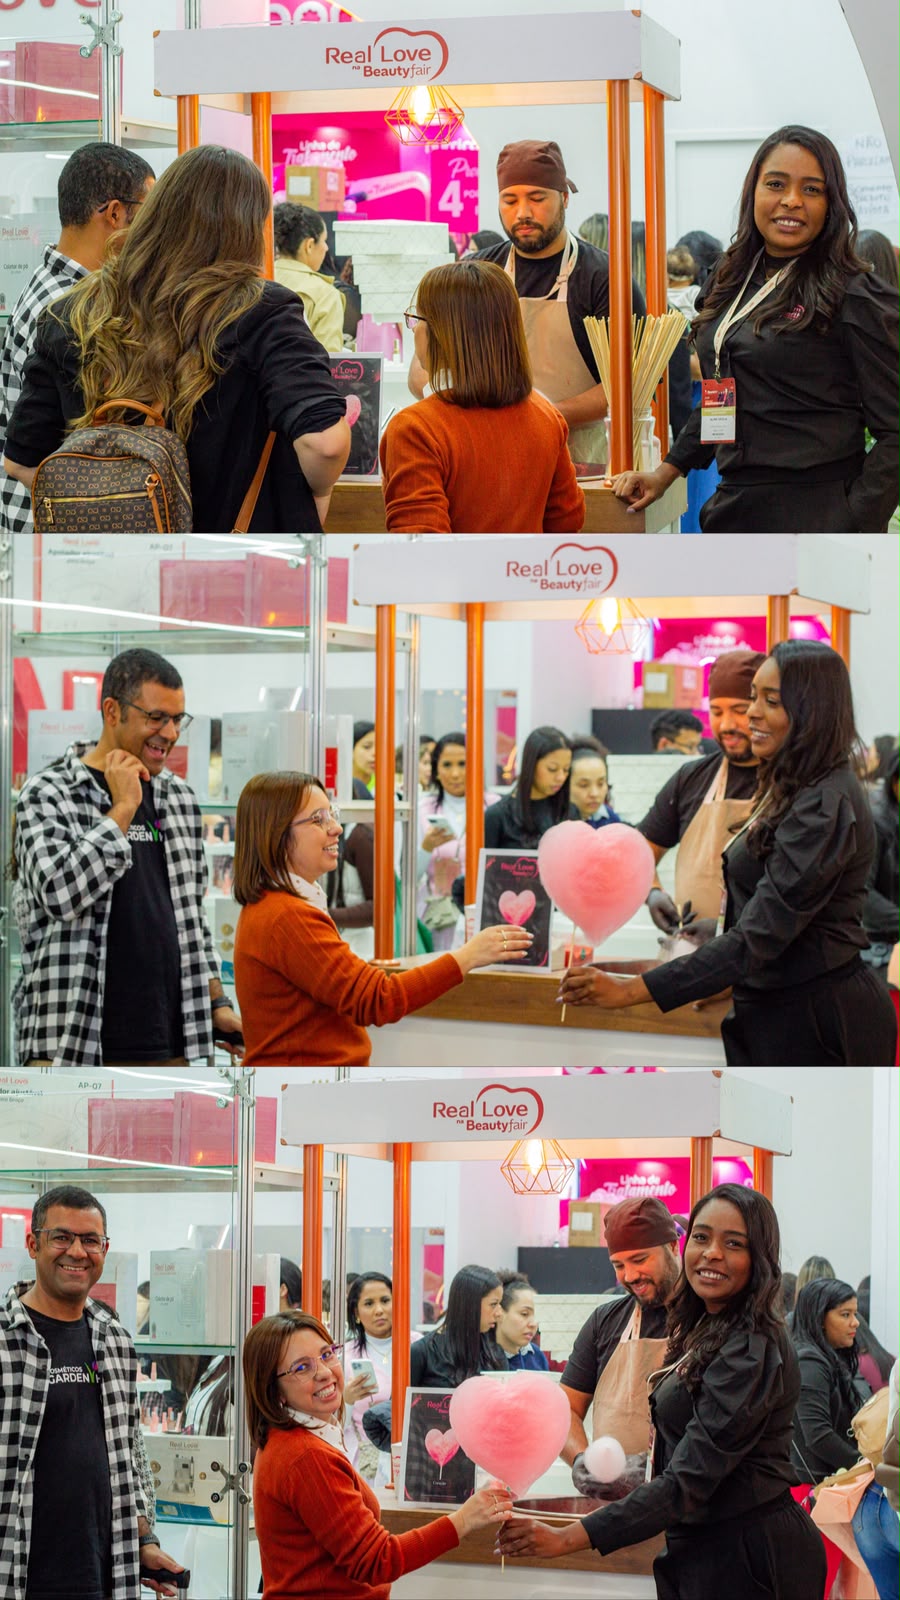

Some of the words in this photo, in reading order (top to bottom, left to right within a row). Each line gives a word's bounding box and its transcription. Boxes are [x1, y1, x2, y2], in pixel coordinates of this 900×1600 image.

[325, 45, 372, 64] Real
[380, 45, 432, 62] Love
[438, 179, 464, 218] 4
[340, 366, 358, 374] Love
[506, 560, 549, 577] Real
[556, 560, 603, 576] Love
[433, 1100, 475, 1118] Real
[482, 1101, 528, 1117] Love
[647, 1175, 661, 1185] de
[50, 1365, 82, 1375] OSMÉTICOS
[49, 1372, 90, 1385] GARDEN
